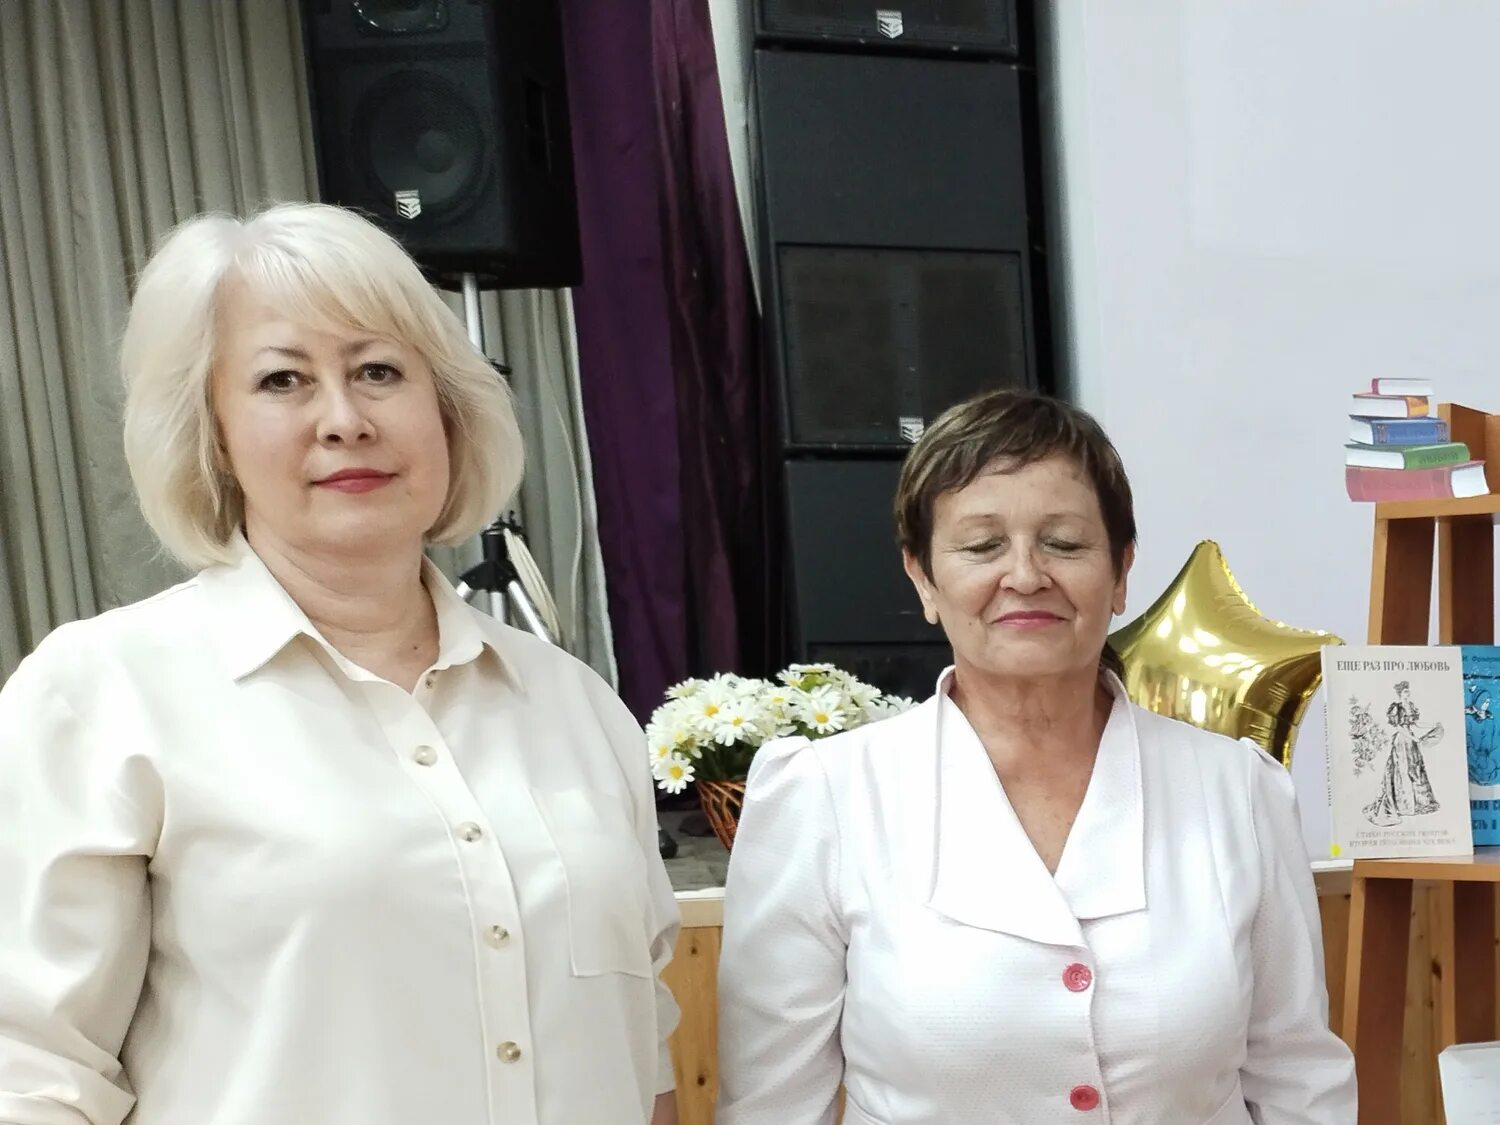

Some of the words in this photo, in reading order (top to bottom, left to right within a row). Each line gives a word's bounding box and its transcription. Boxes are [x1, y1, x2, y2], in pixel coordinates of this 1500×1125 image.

[1336, 660, 1361, 672] ЕЩЕ
[1363, 660, 1381, 671] РАЗ
[1383, 660, 1404, 671] ПРО
[1406, 660, 1450, 672] ЛЮБОВЬ
